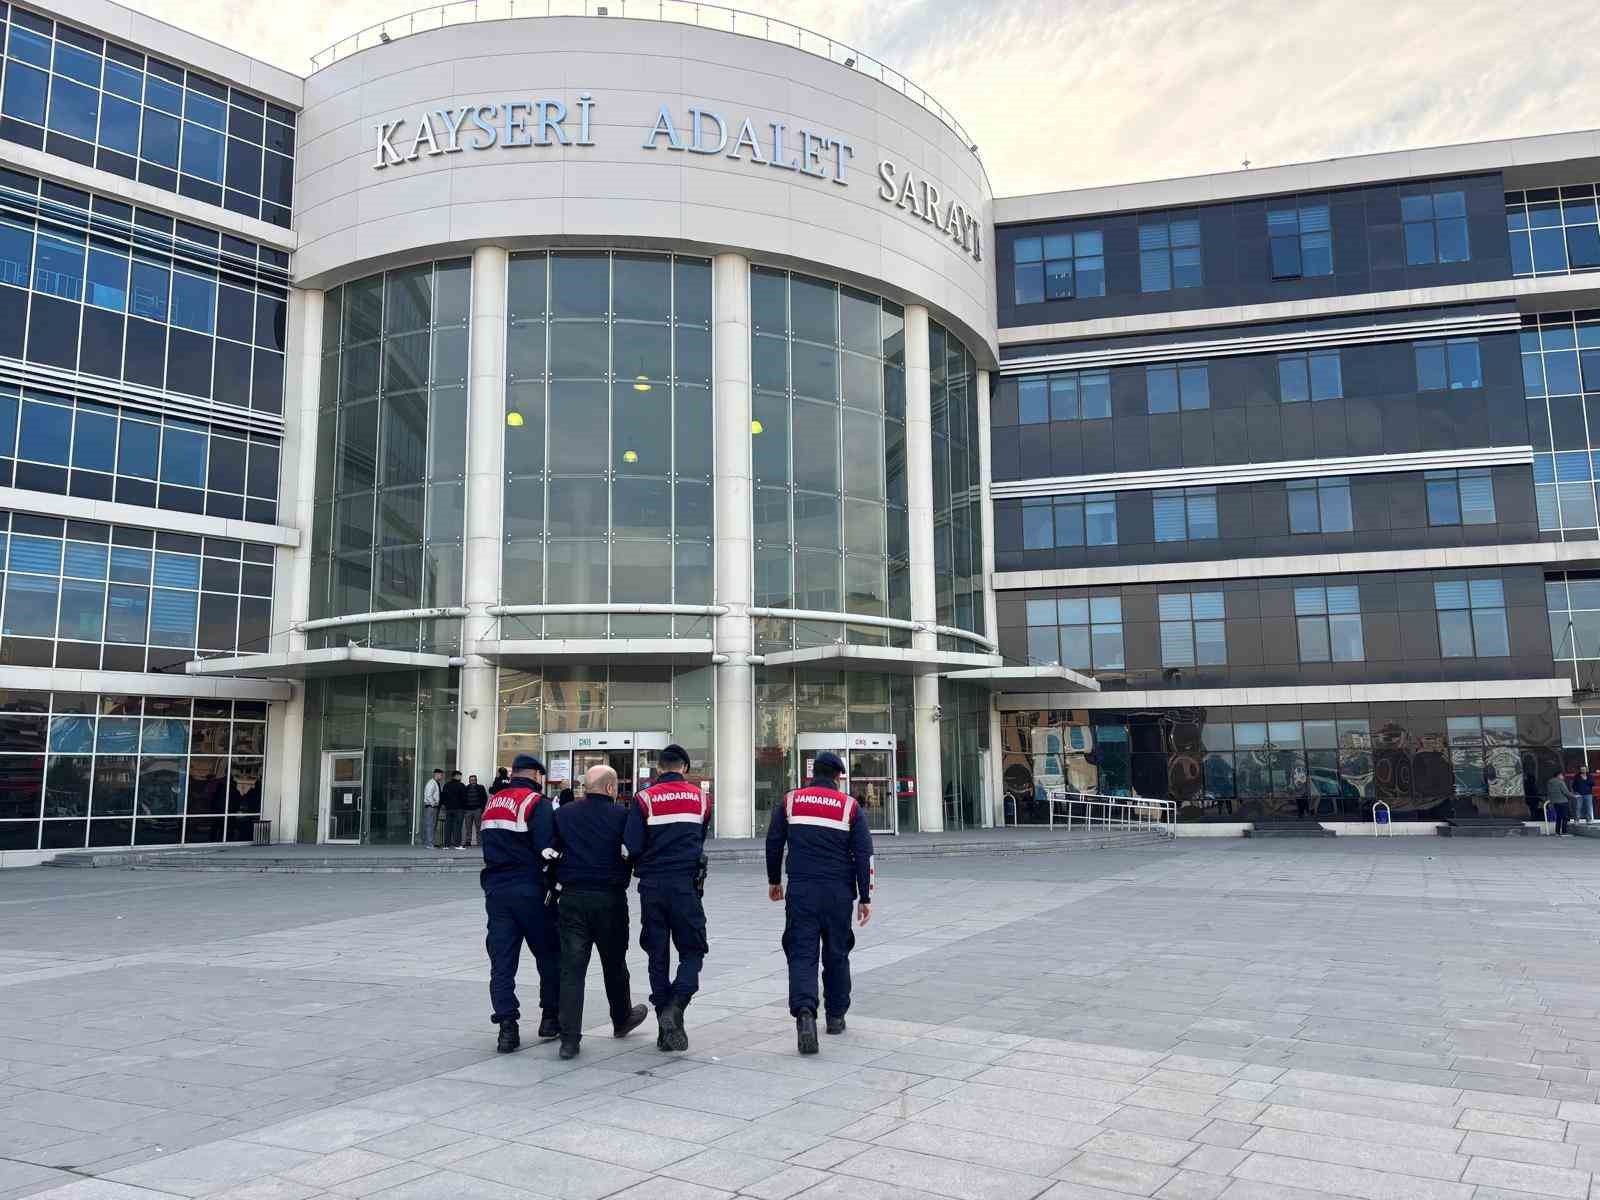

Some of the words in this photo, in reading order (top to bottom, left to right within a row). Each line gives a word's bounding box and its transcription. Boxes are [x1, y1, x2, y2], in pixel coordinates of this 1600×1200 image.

[372, 92, 595, 169] KAYSERİ
[641, 103, 854, 186] ADALET
[879, 160, 981, 262] SARAYI
[652, 791, 699, 802] JANDARMA
[795, 795, 841, 808] JANDARMA
